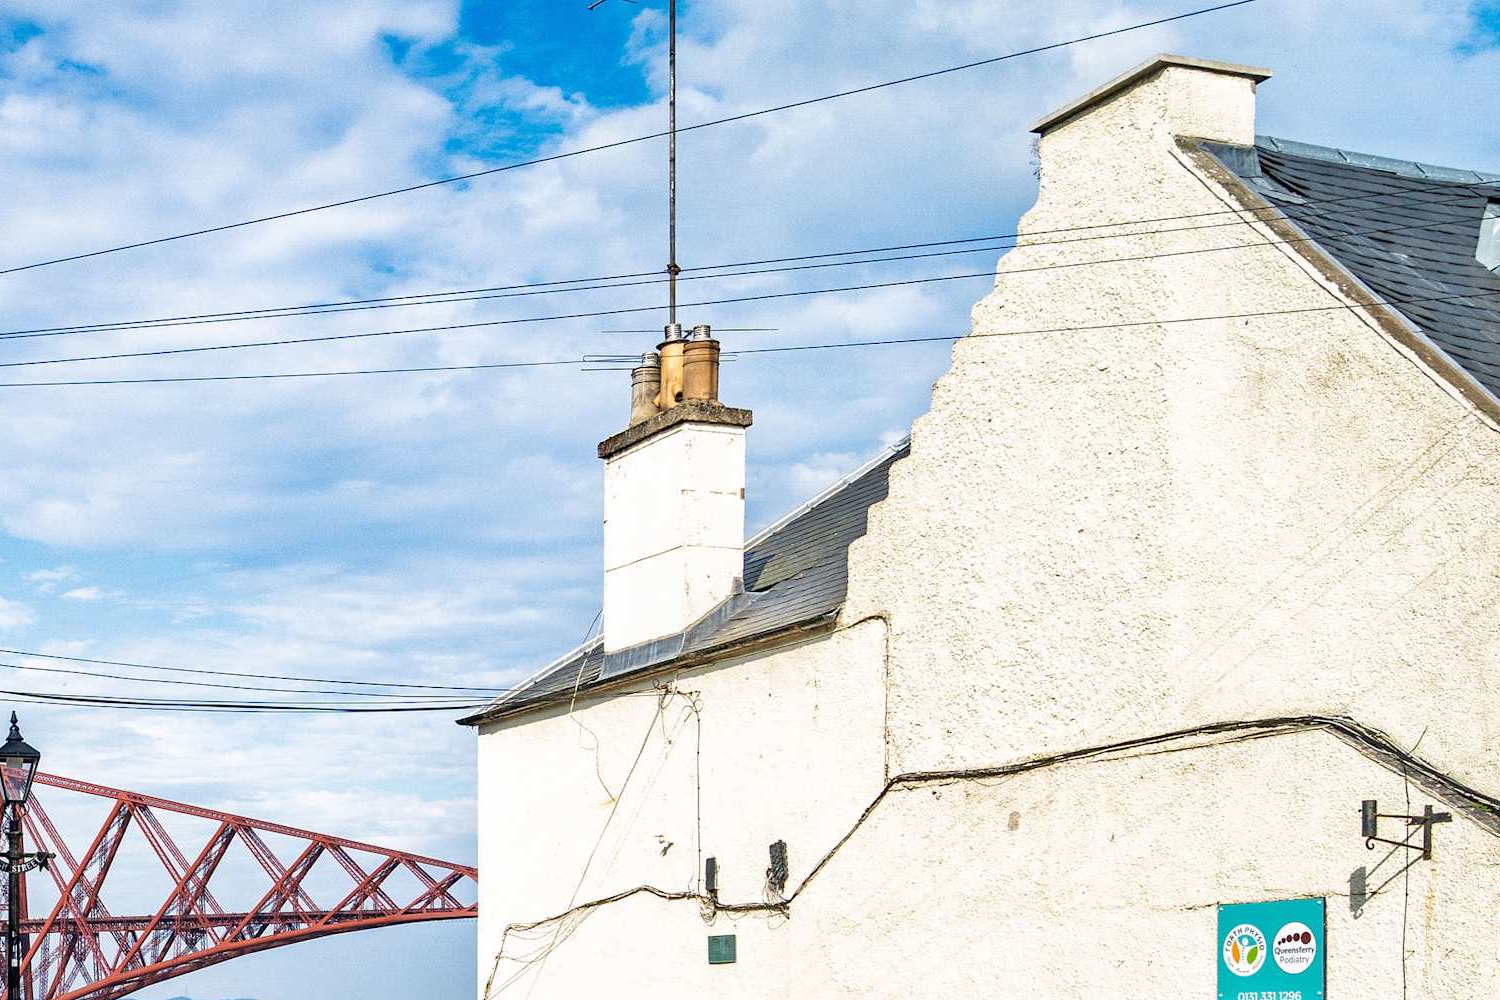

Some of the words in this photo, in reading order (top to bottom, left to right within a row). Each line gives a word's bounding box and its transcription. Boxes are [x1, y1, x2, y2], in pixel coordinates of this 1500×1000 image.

[1244, 926, 1265, 951] PHYSIO
[1274, 946, 1315, 955] Queensferry
[1279, 955, 1310, 964] Podiatry
